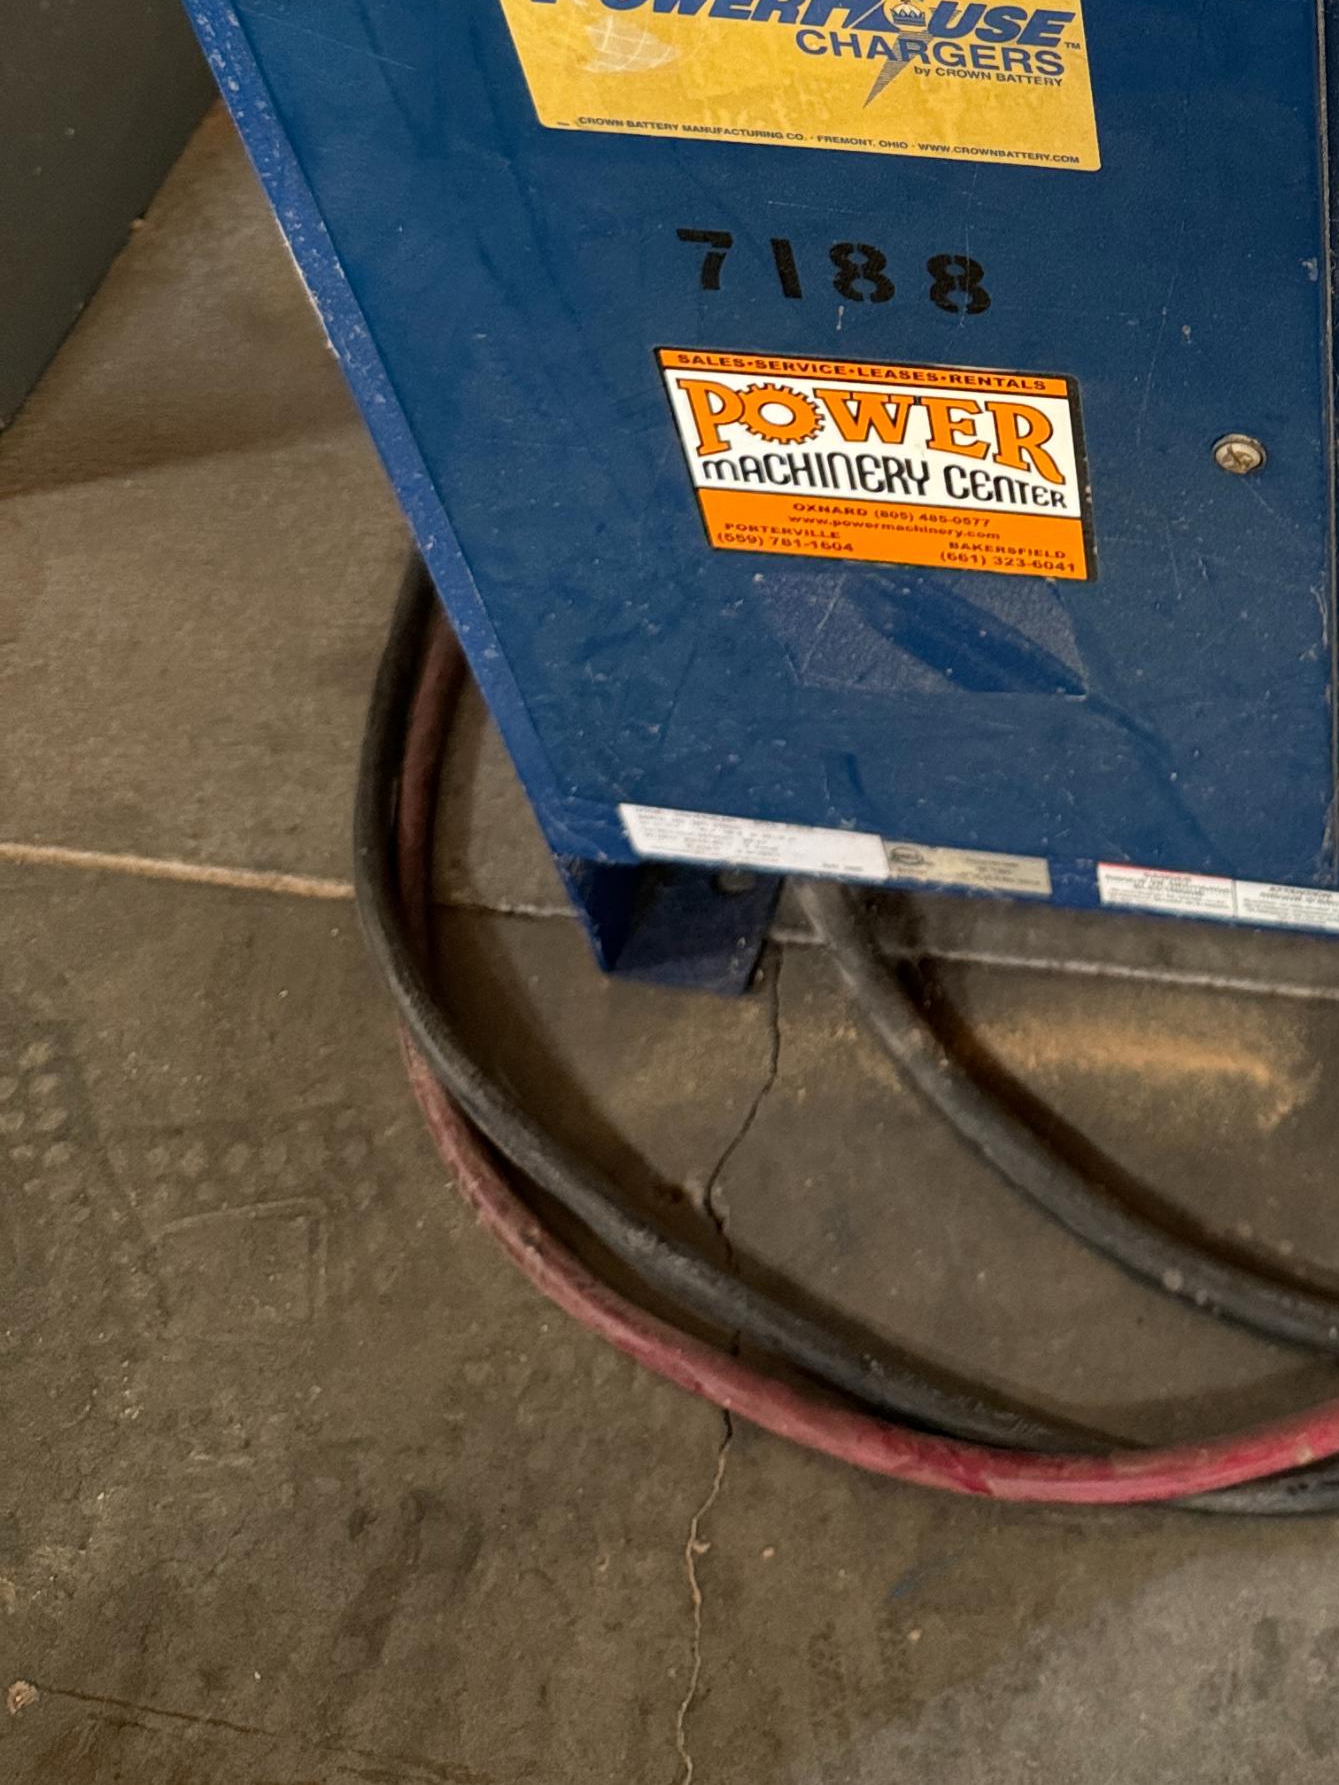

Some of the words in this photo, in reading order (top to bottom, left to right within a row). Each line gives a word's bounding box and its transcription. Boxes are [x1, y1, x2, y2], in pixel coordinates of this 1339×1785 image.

[796, 29, 1064, 75] CHARGERS
[913, 66, 931, 77] by
[935, 67, 992, 80] CROWN
[996, 73, 1063, 87] BATTERY
[578, 116, 624, 127] CROWN
[627, 120, 679, 131] BATTERY
[682, 124, 784, 139] MANUFACTURING
[879, 141, 908, 150] OHIO
[917, 143, 1080, 164] WWW.CROWNBATTERY.COM
[676, 228, 992, 314] 7188
[675, 378, 1067, 486] POWER
[943, 464, 1068, 509] CENTER
[788, 515, 1001, 540] www.powermachinery.com
[793, 502, 868, 517] OXNARD
[874, 509, 914, 522] (805)
[724, 522, 841, 539] PORTERVILLE
[949, 541, 1066, 559] BAKERSFIELD
